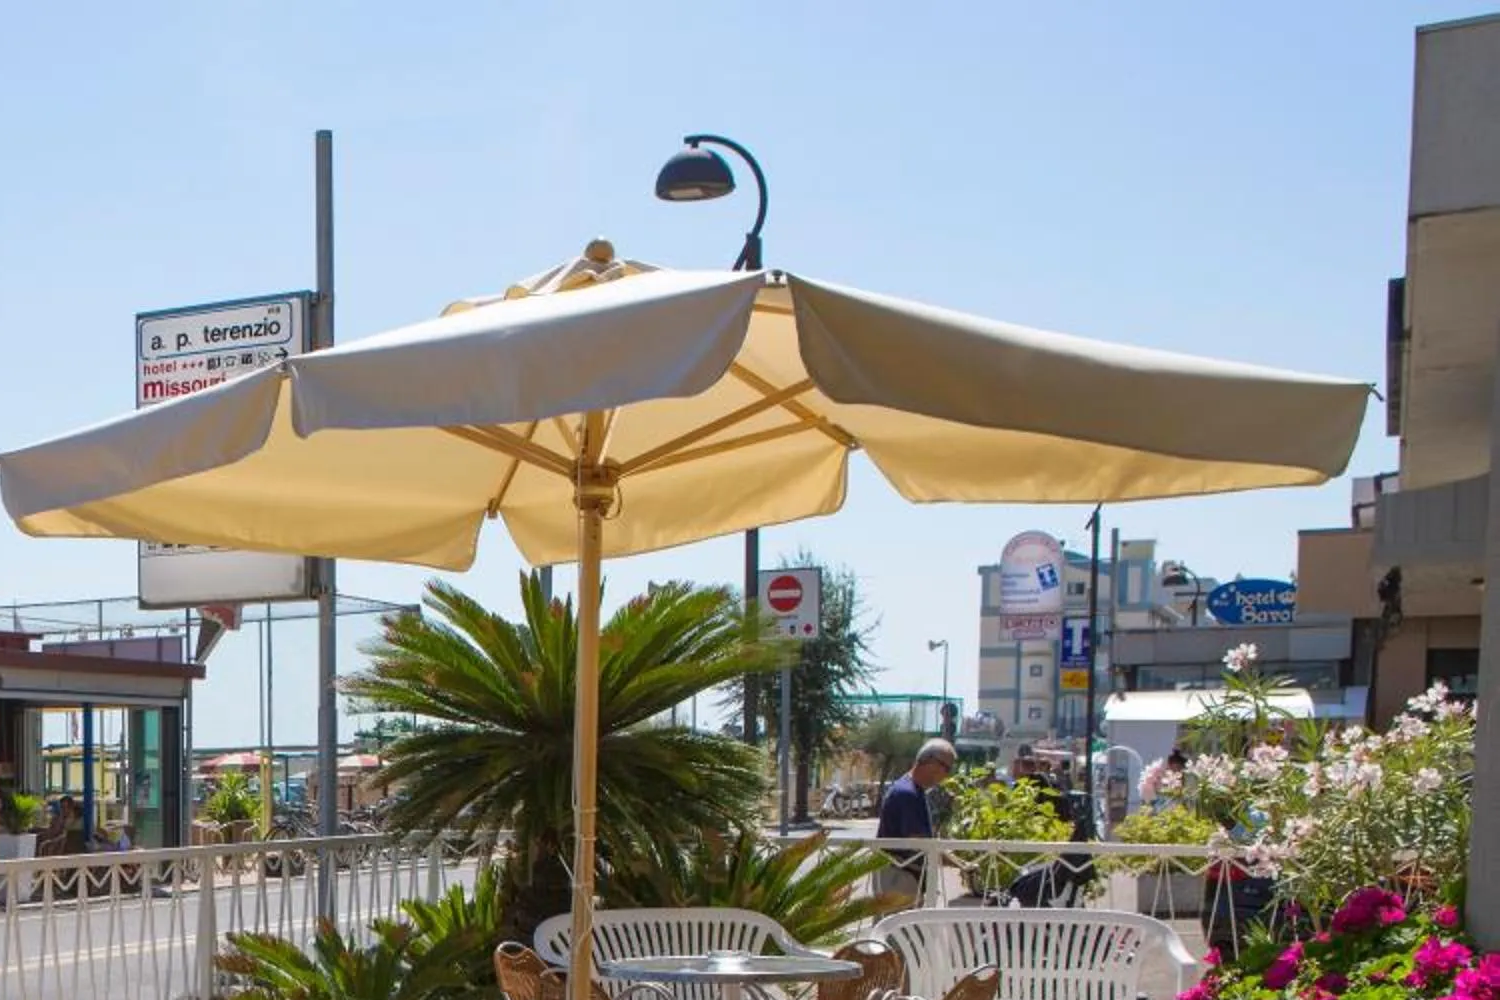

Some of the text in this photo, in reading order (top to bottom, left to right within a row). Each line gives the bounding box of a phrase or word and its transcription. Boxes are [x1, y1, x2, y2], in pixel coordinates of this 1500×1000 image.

[151, 316, 281, 351] a. p. terenzio
[143, 360, 177, 376] hotel
[1236, 588, 1276, 606] hotel
